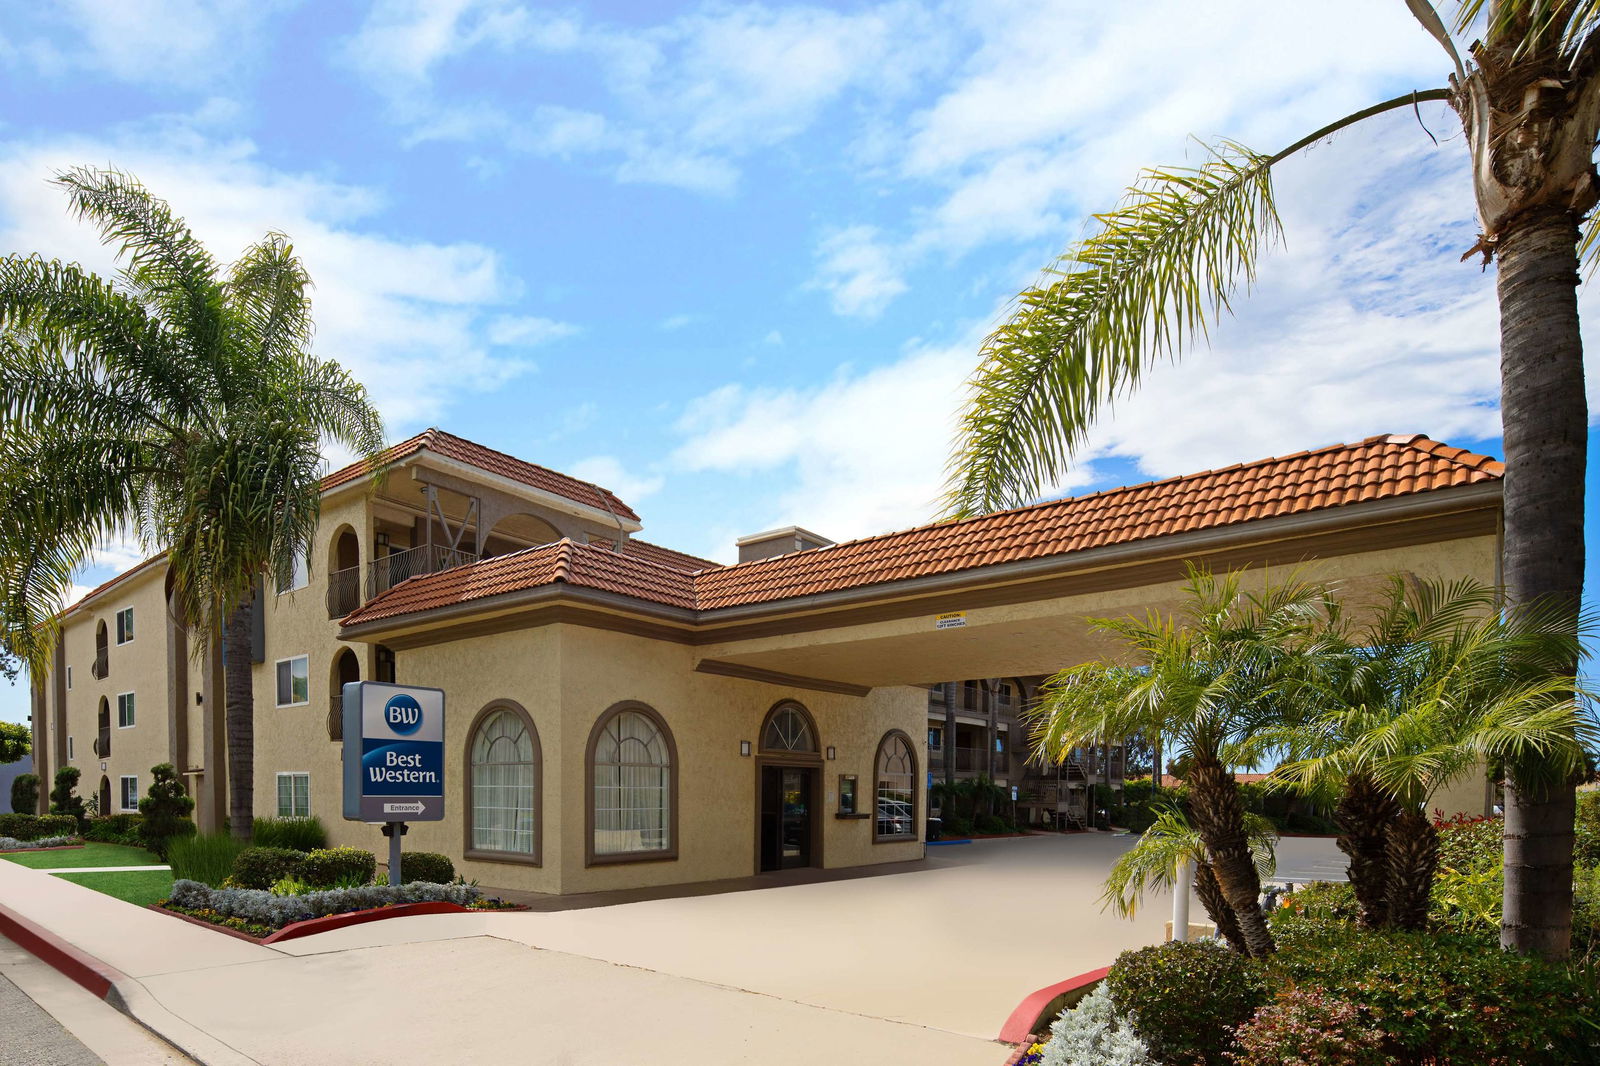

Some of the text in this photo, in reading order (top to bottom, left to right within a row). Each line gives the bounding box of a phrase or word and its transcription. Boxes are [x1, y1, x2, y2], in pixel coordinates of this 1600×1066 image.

[389, 706, 419, 724] BW
[386, 751, 422, 767] Best
[369, 767, 436, 783] Western
